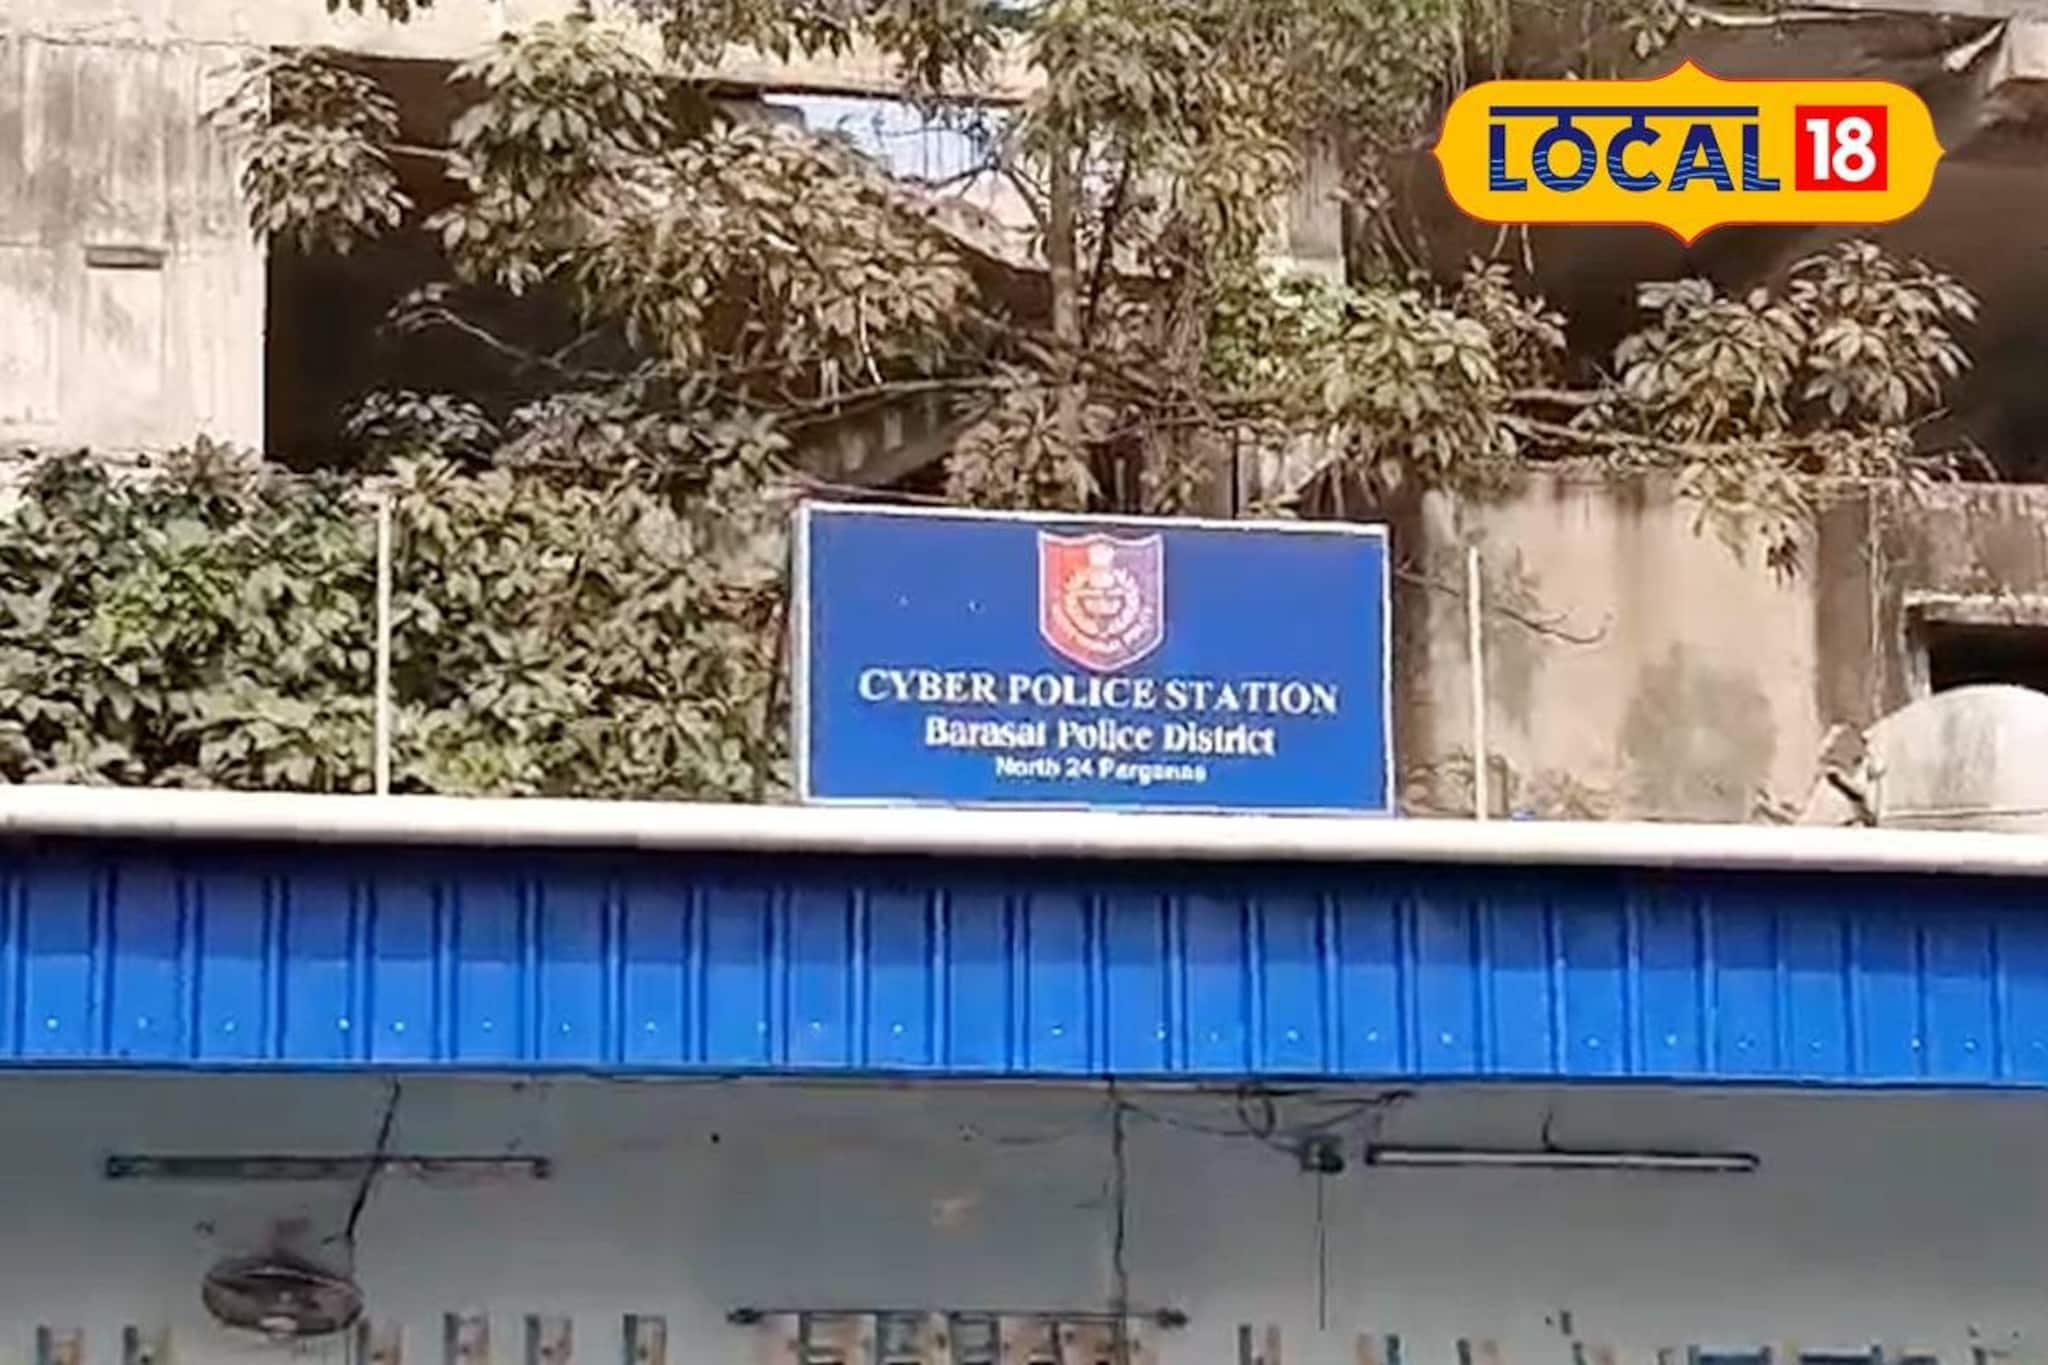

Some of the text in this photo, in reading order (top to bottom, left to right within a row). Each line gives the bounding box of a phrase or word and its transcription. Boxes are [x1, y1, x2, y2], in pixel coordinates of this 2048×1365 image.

[858, 668, 1339, 715] CYBER POLICE STATION
[1058, 717, 1153, 751] Police
[1163, 721, 1276, 757] District
[995, 755, 1060, 778] North
[1064, 756, 1095, 779] 24
